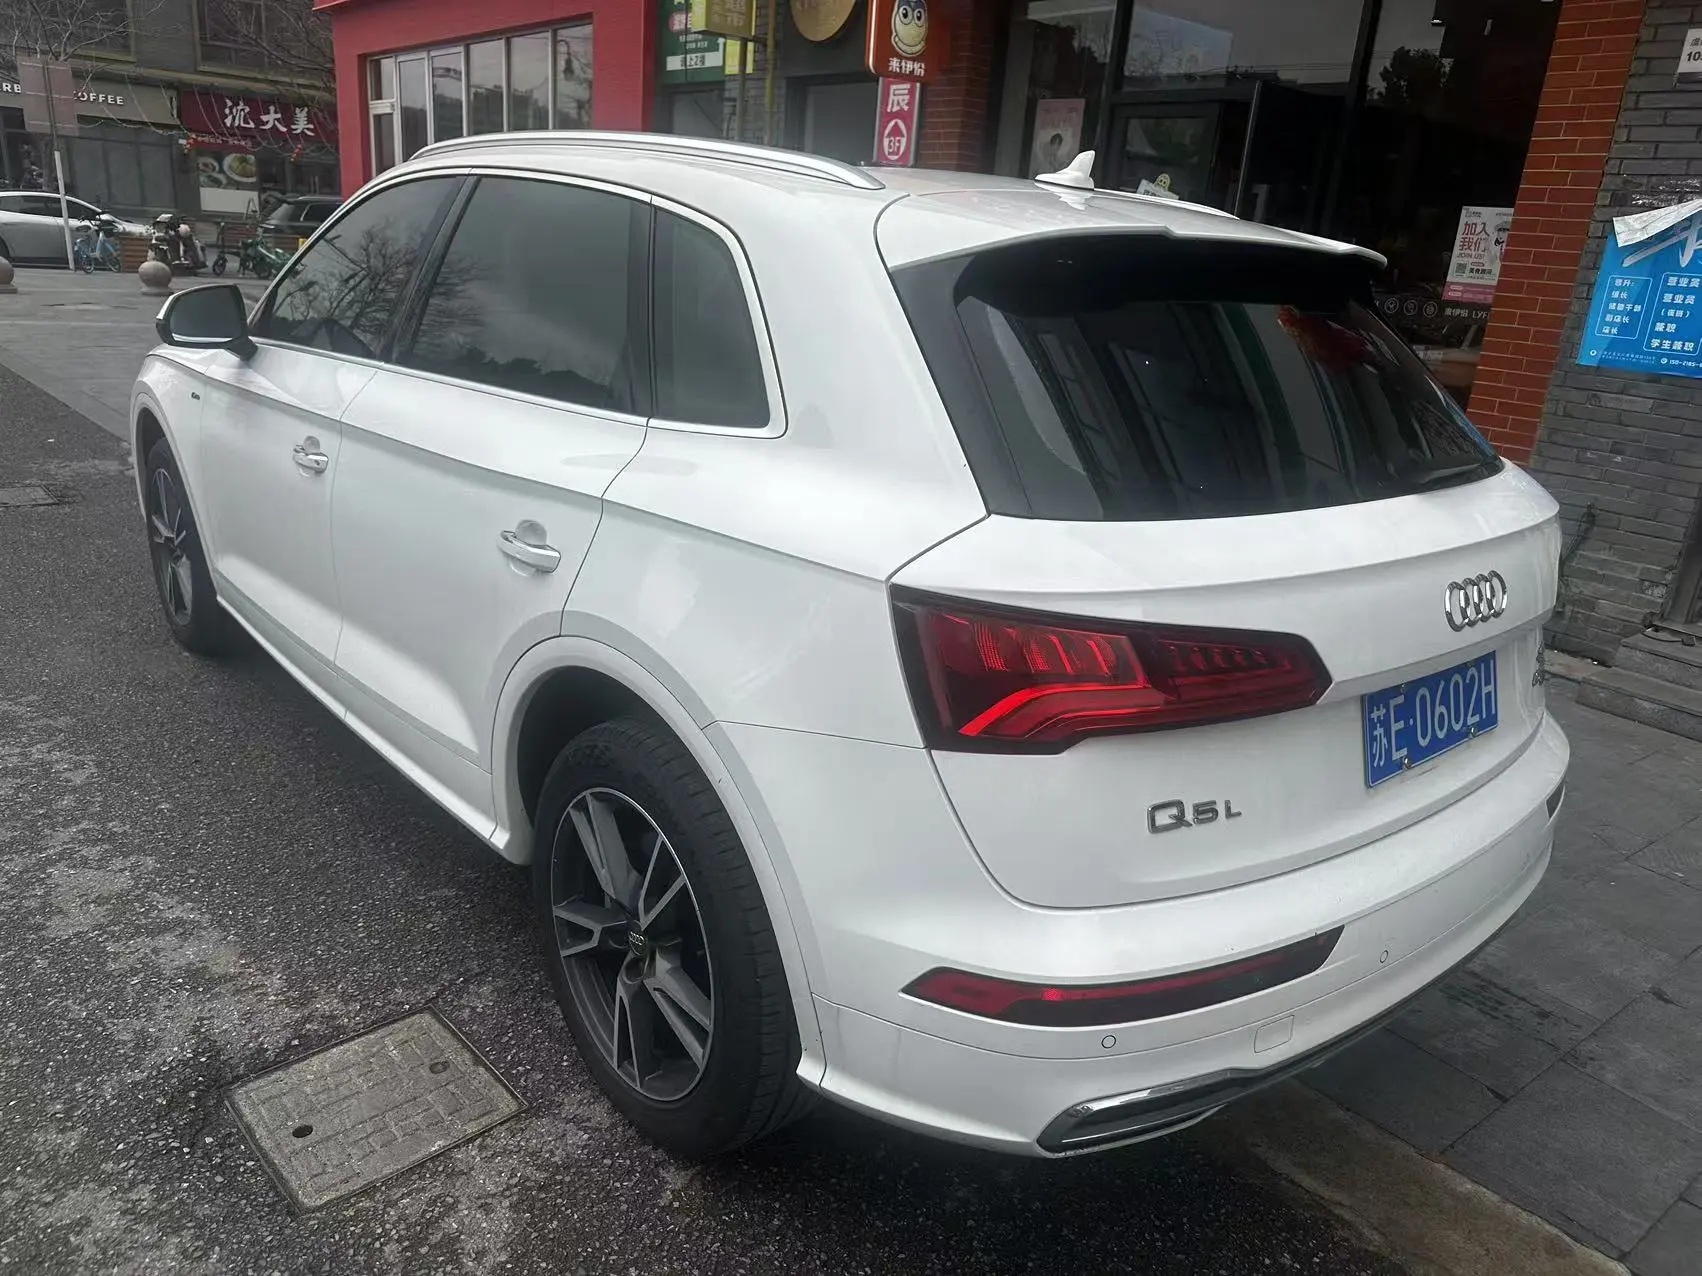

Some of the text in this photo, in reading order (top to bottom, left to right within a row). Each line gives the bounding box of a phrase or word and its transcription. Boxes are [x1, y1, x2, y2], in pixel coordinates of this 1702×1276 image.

[888, 57, 926, 77] 来伊份
[886, 83, 911, 113] 辰
[888, 136, 903, 154] 3F
[1462, 221, 1490, 237] 加入
[1459, 237, 1486, 253] 我们
[1667, 276, 1701, 288] 营业员
[1662, 293, 1696, 305] 营业员
[1605, 314, 1630, 324] 副店长
[1602, 326, 1619, 335] 店长
[1654, 322, 1677, 333] 兼职
[1650, 338, 1695, 352] 学生兼职
